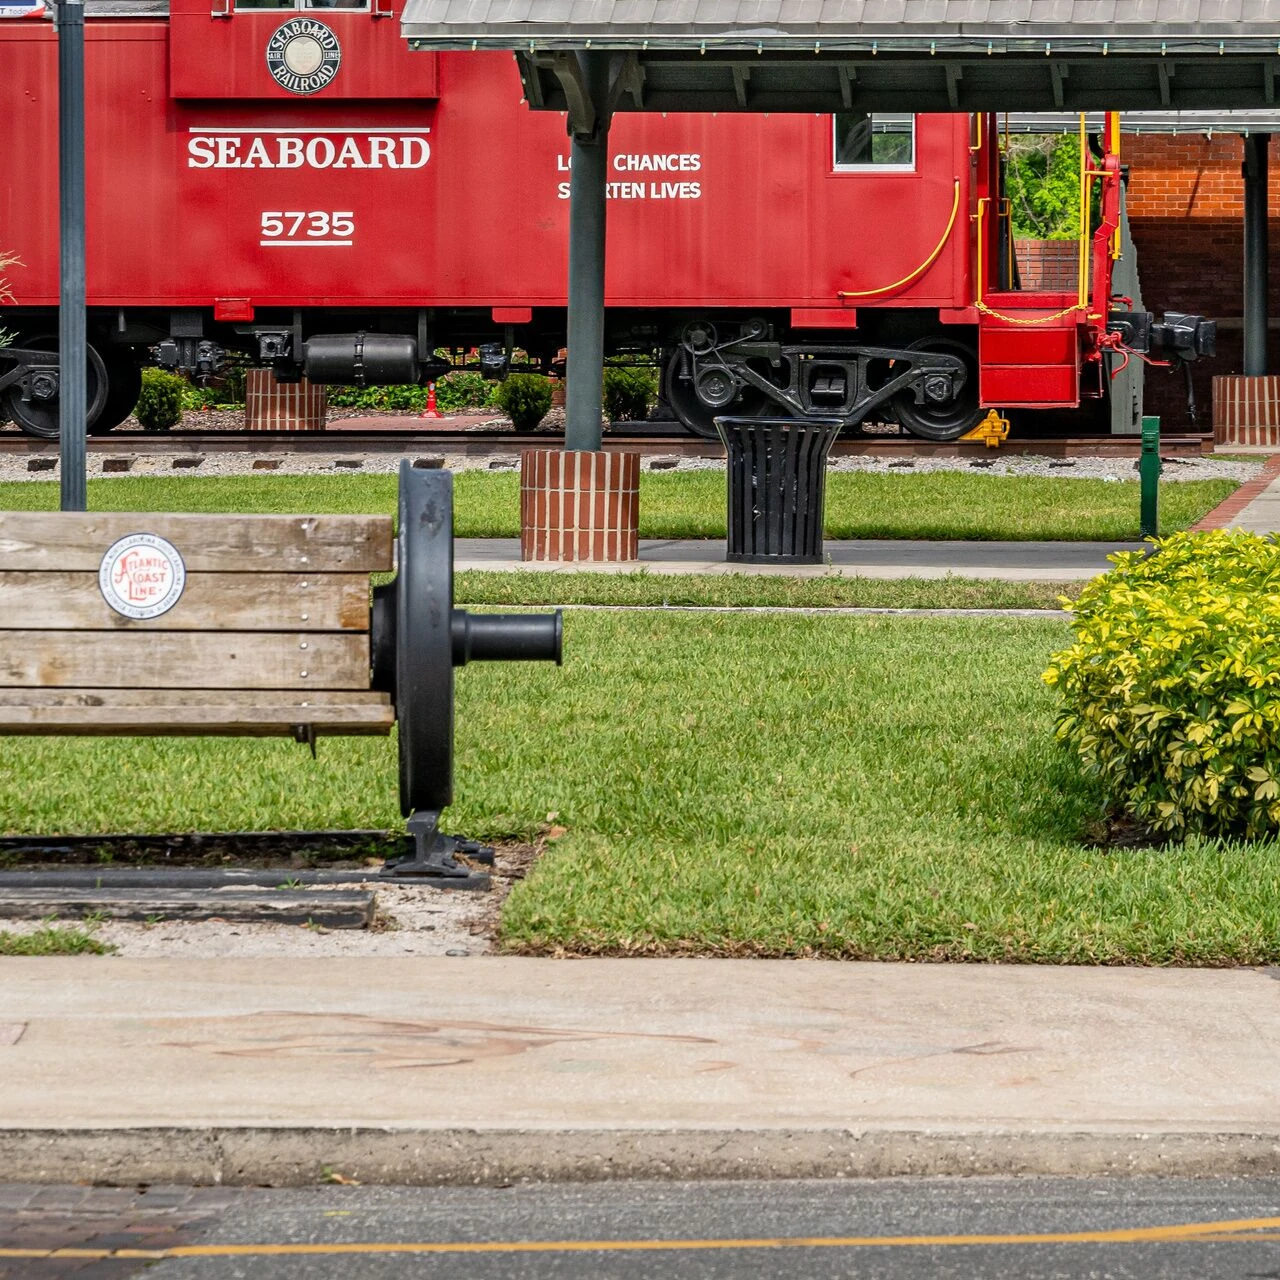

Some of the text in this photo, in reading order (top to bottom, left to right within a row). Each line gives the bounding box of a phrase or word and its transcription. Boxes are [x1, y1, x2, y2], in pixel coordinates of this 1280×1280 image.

[271, 21, 336, 51] SEABOARD
[273, 65, 334, 90] RAILROAD
[188, 137, 431, 169] SEABOARD
[613, 154, 701, 171] CHANCES
[650, 182, 702, 199] LIVES
[260, 211, 355, 237] 5735
[114, 551, 168, 584] ATLANTIC
[132, 569, 166, 585] COAST
[129, 580, 157, 601] LINE
